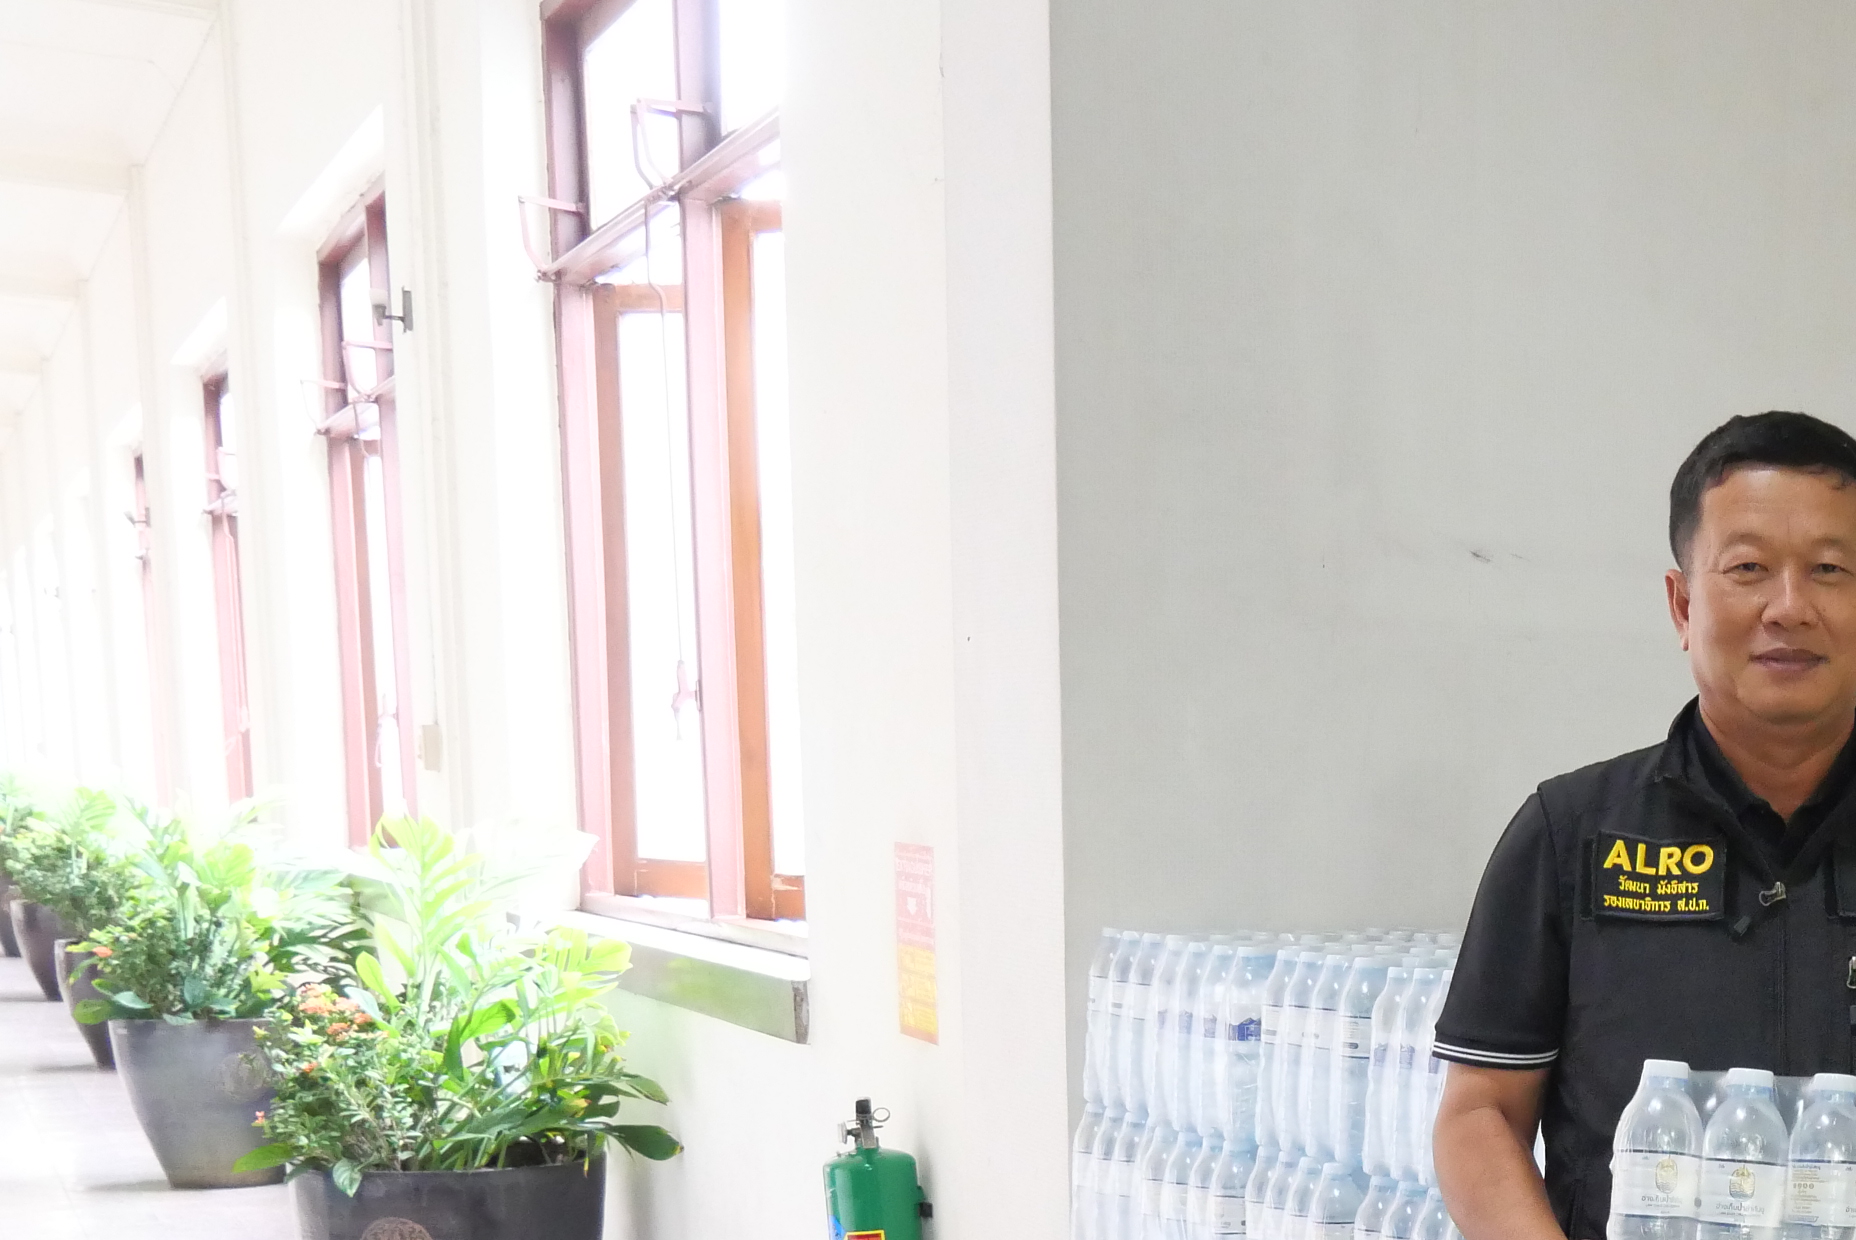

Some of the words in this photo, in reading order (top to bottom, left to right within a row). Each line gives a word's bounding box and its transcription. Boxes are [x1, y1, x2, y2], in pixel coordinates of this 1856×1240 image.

[1603, 839, 1715, 876] ALRO
[1618, 874, 1650, 893] วัฒนา
[1603, 894, 1672, 912] รองเลขาธิการ
[1676, 897, 1709, 911] ส.ป.ก.
